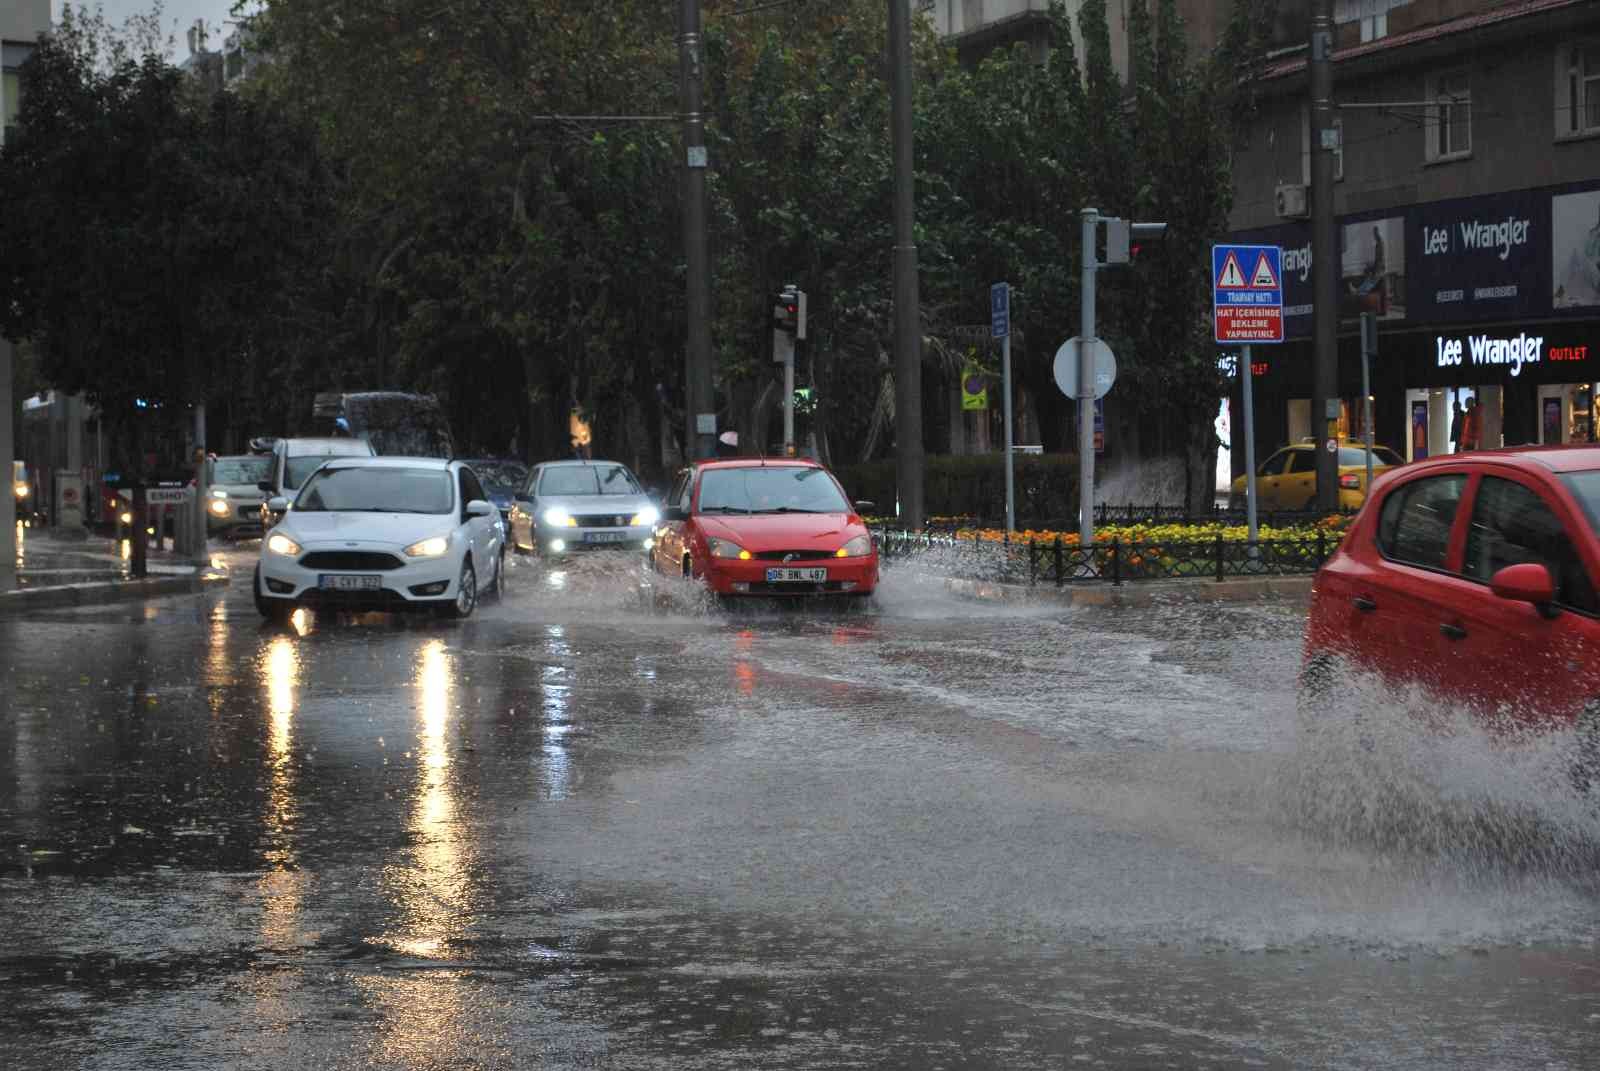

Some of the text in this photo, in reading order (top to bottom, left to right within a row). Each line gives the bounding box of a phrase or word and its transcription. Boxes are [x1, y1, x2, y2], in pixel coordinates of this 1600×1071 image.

[1424, 216, 1530, 261] Lee Wrangler
[1281, 240, 1313, 282] rangl
[1217, 308, 1233, 317] HAT
[1231, 319, 1269, 328] BEKLEME
[1225, 329, 1275, 339] YAPMAYINIZ
[1436, 332, 1587, 377] Lee Wrangler OUTLET
